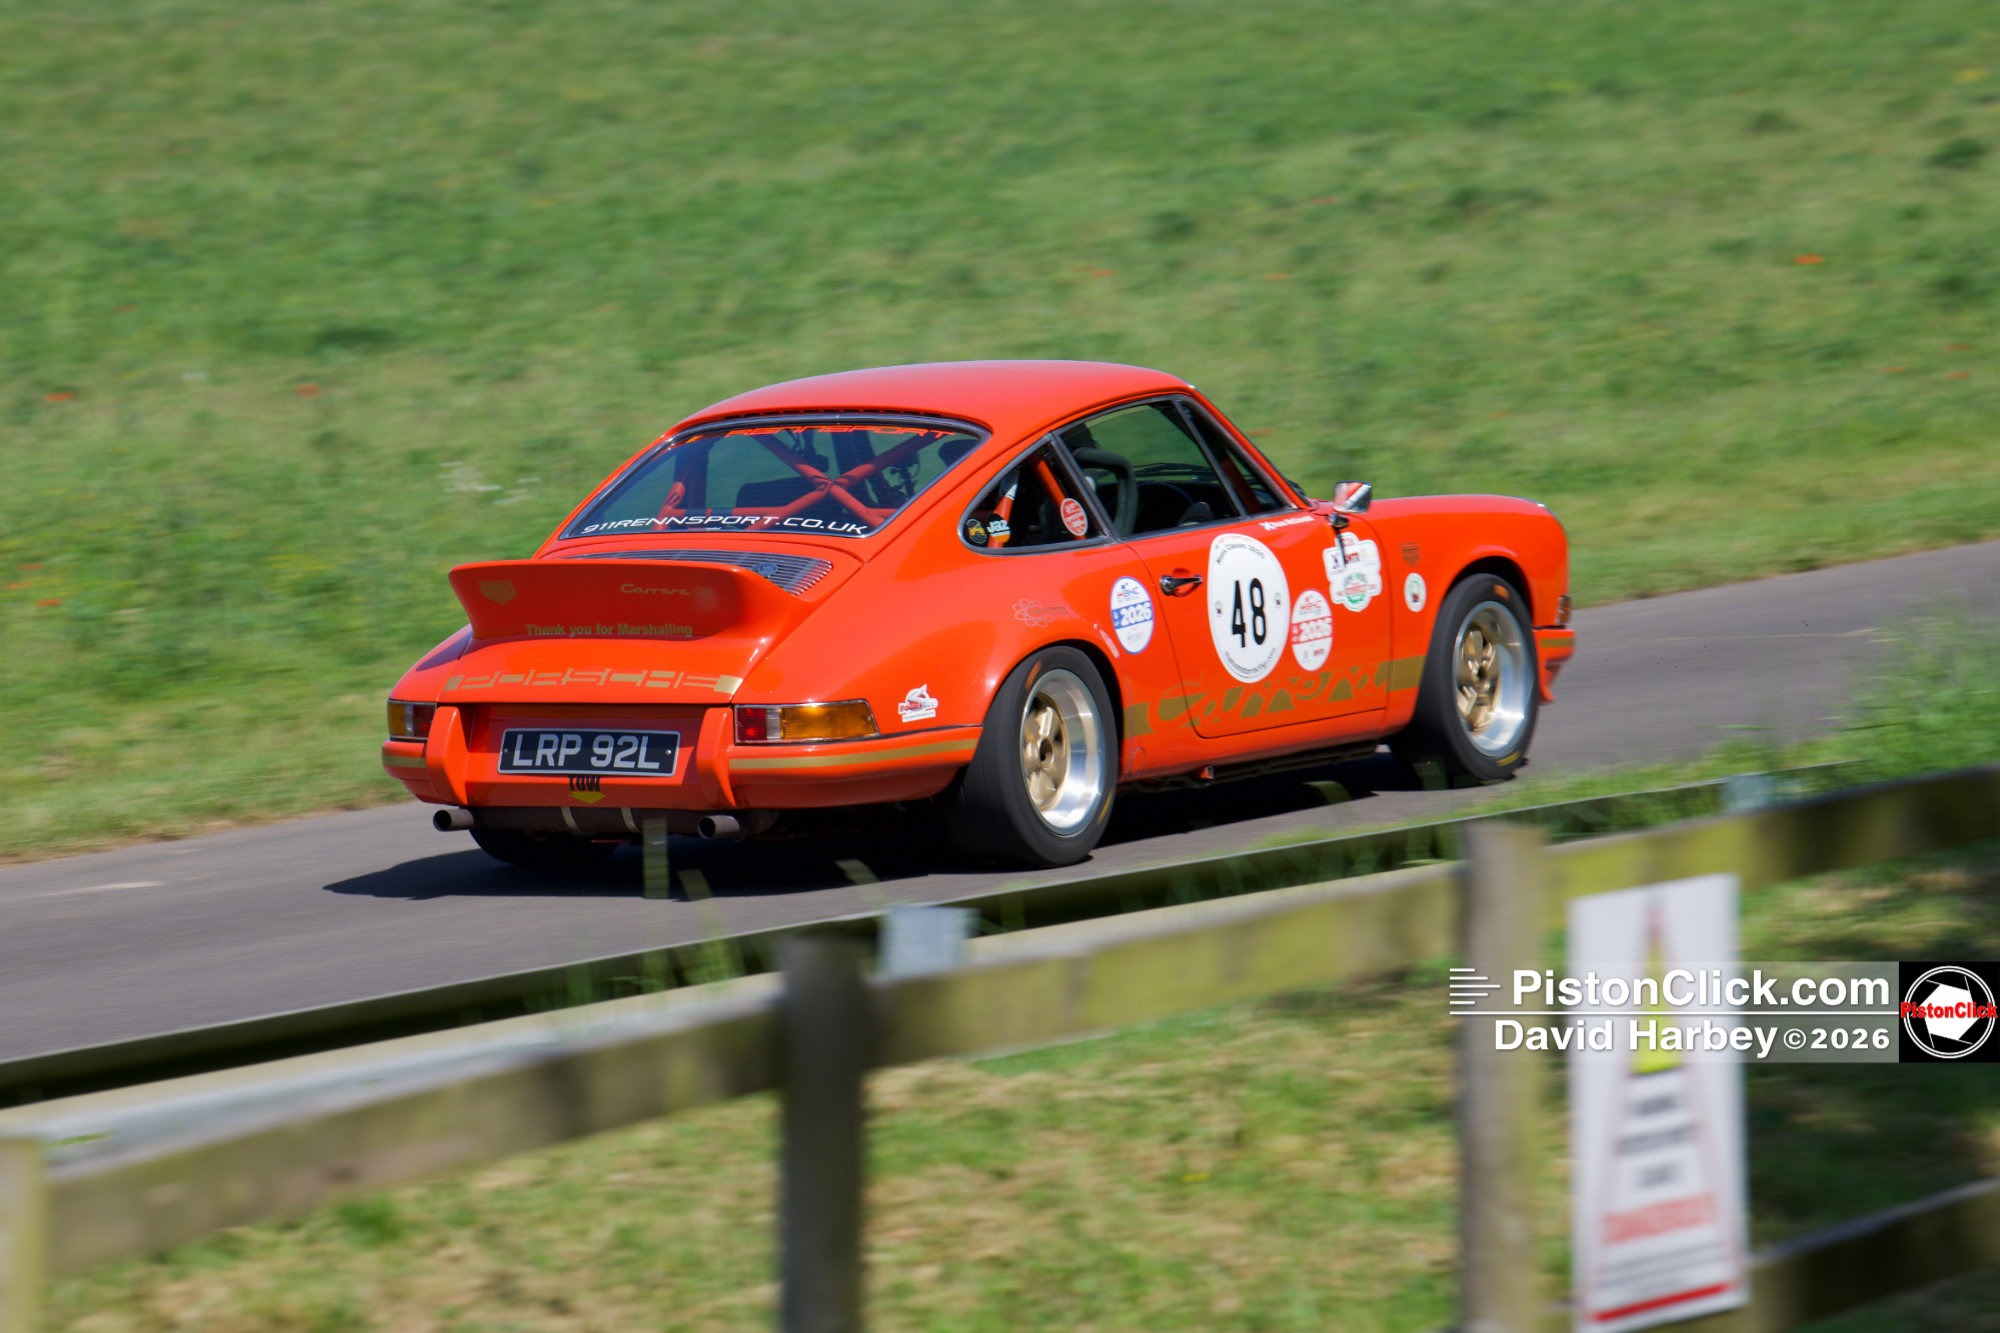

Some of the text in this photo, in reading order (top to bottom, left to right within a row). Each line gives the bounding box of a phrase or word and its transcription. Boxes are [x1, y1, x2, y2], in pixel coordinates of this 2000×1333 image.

[581, 515, 868, 534] 911RENNSPORT.CO.UK
[621, 583, 690, 596] Carrera
[1119, 602, 1153, 626] 2026
[1232, 577, 1267, 648] 48
[525, 623, 693, 637] Thank you for Marshalling
[448, 668, 720, 692] PORSCHE
[1147, 660, 1388, 735] Carrera
[512, 733, 661, 770] LRP 92L
[568, 775, 601, 791] TOW
